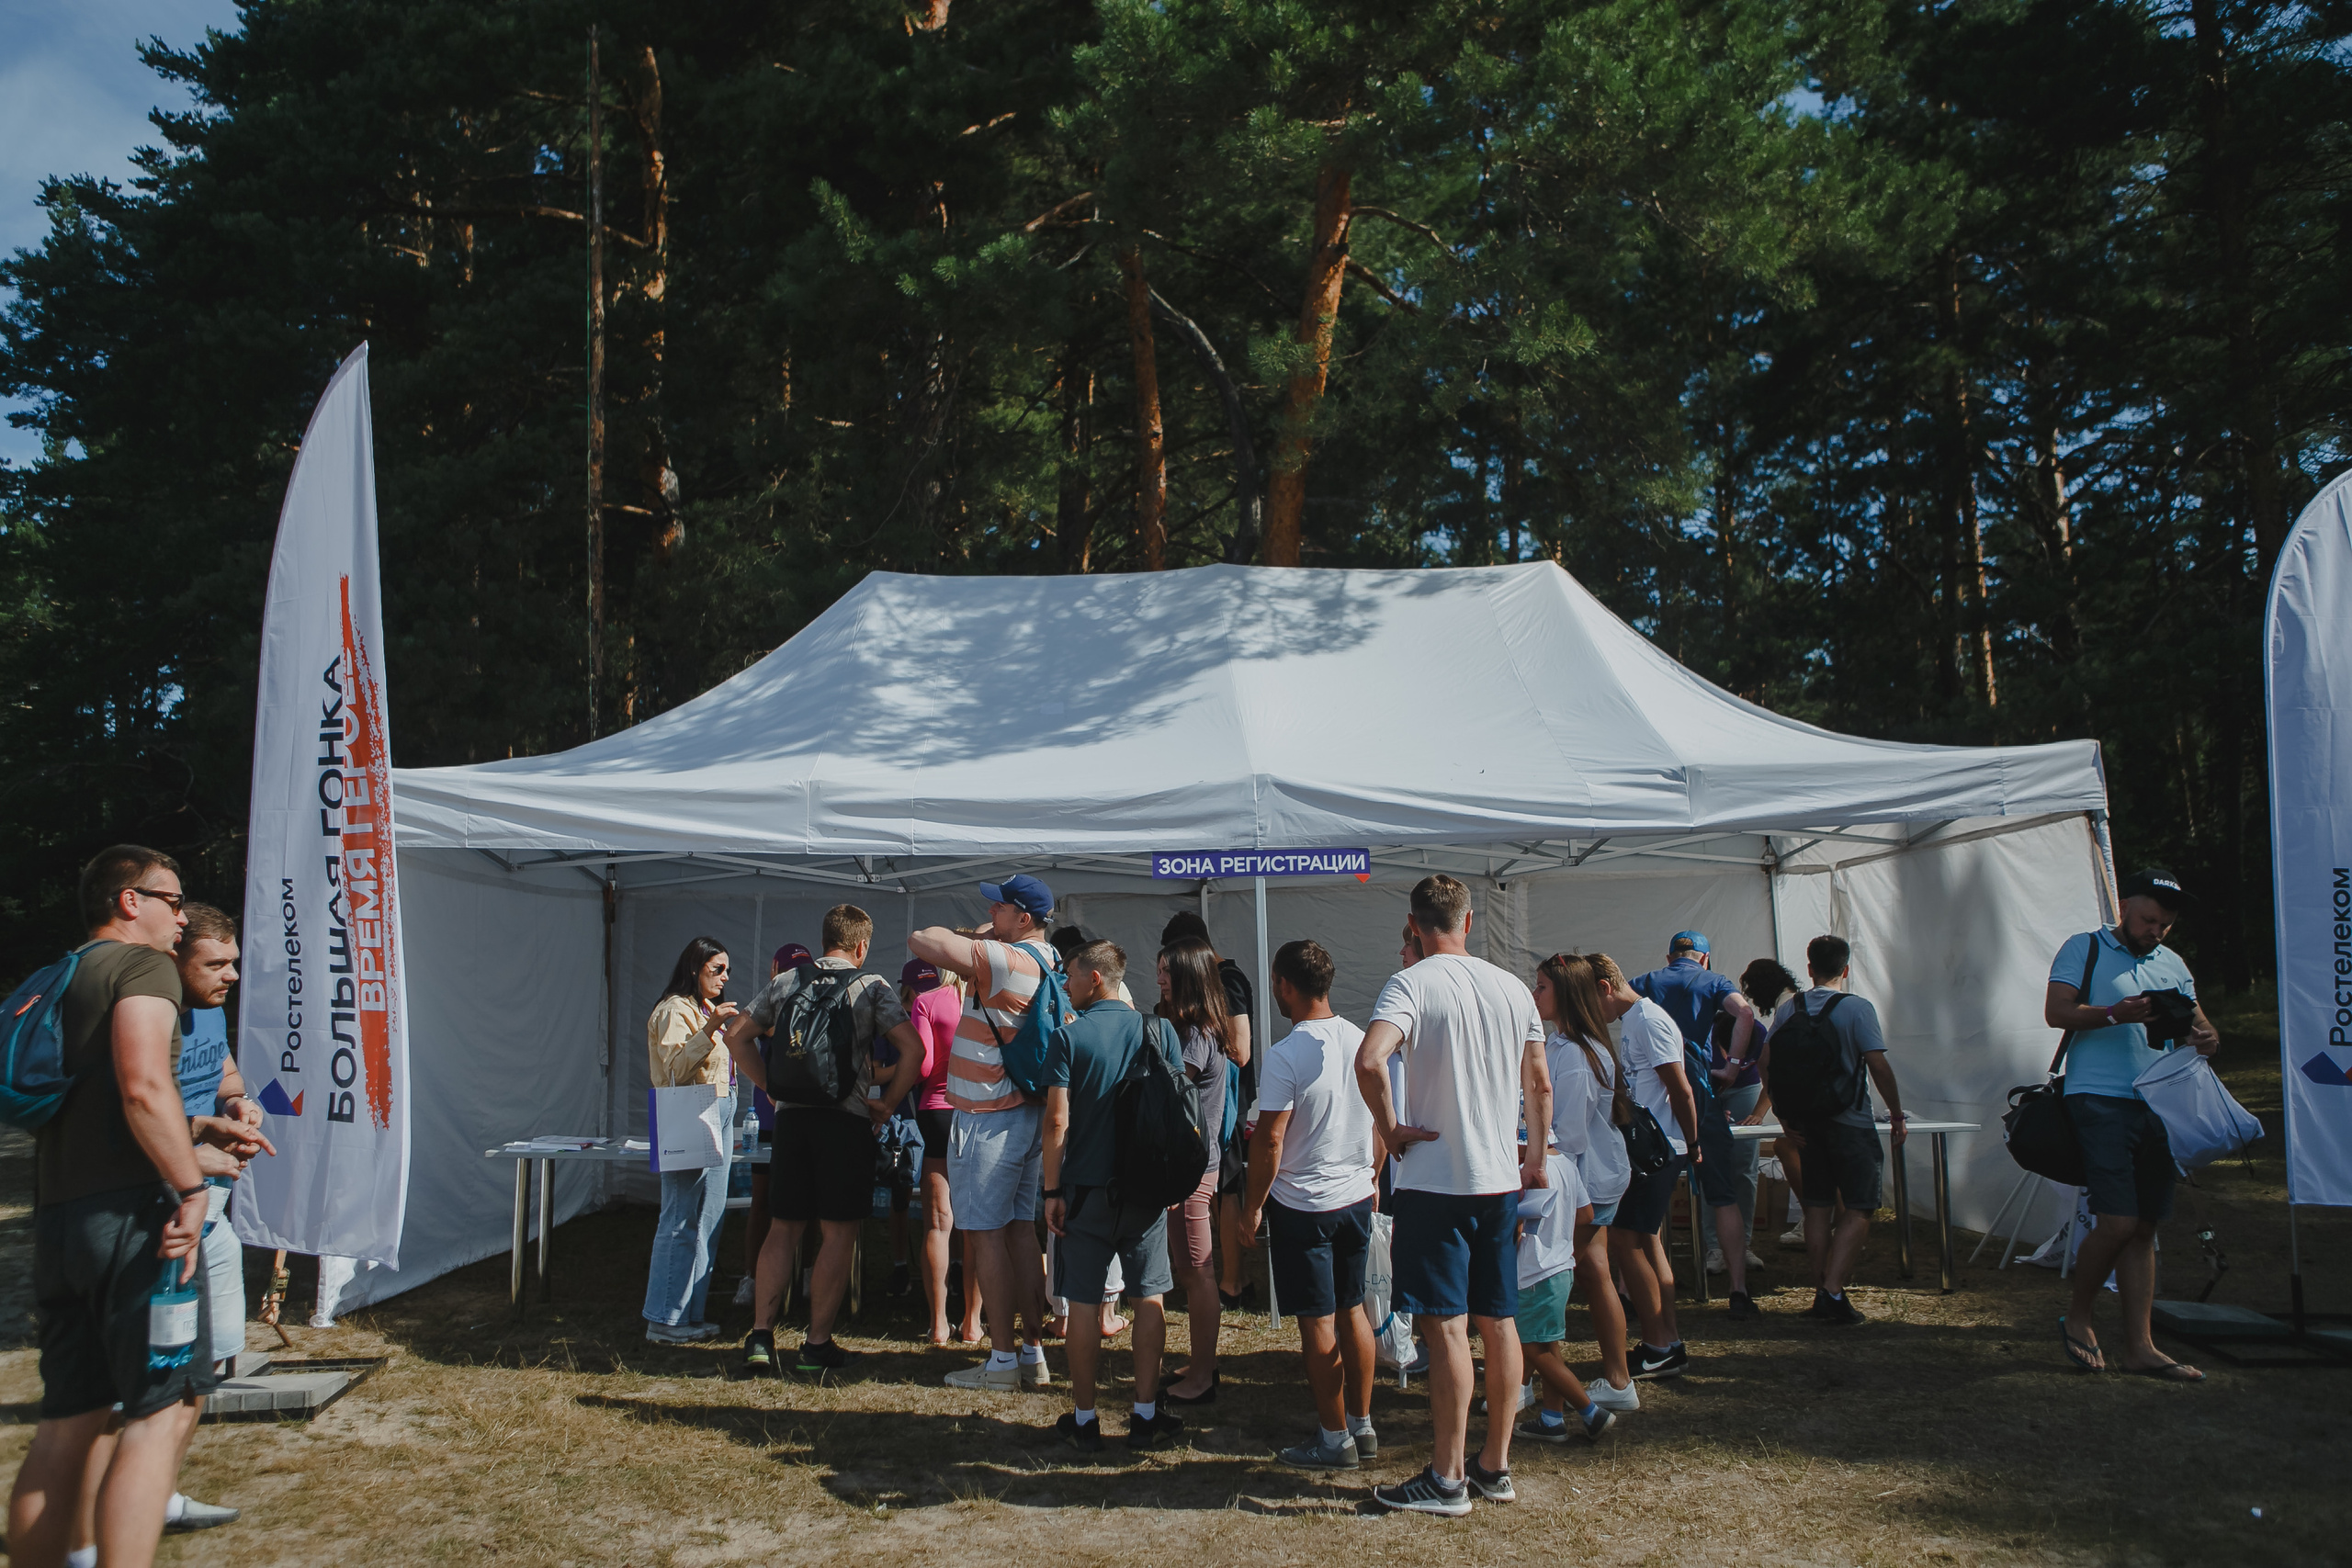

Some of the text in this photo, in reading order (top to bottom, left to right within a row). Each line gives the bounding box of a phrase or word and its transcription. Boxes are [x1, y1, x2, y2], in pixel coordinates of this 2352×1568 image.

[318, 654, 356, 1123] БОЛЬШАЯ ГОНКА
[347, 848, 387, 1011] ВРЕМЯ
[1158, 854, 1365, 874] ЗОНА РЕГИСТРАЦИИ
[281, 877, 301, 1073] Ростелеком
[2329, 867, 2352, 1046] Ростелеком
[178, 1037, 225, 1076] ntage
